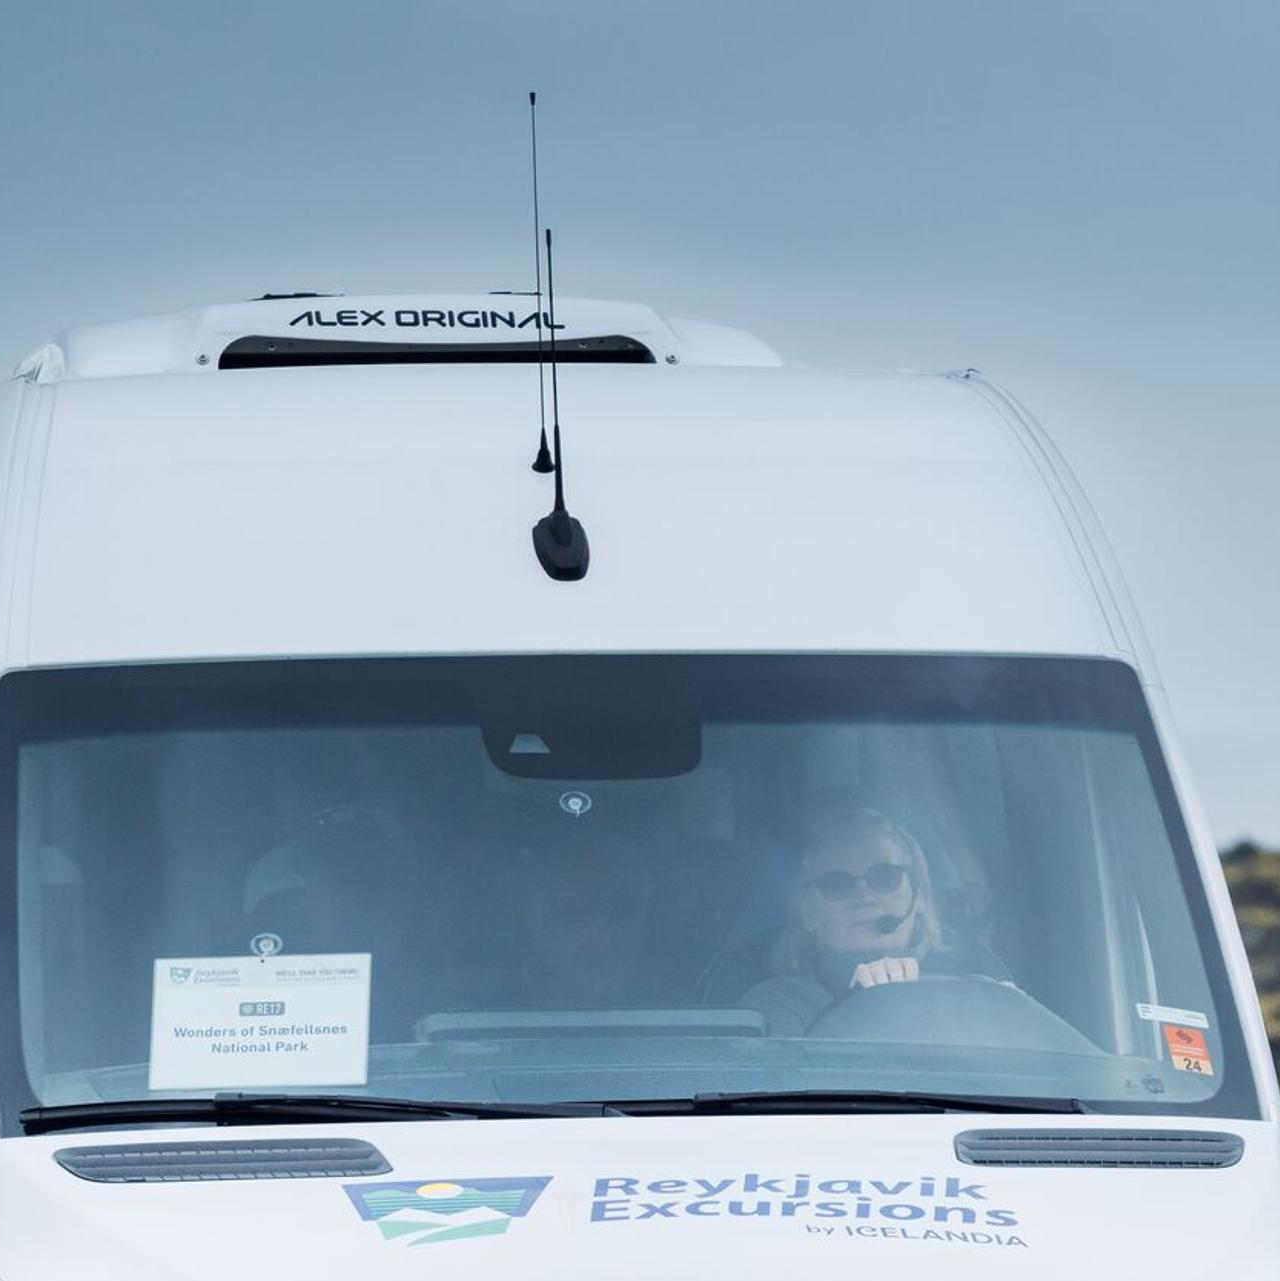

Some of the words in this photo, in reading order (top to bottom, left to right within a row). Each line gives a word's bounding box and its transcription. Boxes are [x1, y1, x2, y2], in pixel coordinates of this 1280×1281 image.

[289, 310, 385, 326] ALEX
[394, 310, 565, 329] ORIGINAL
[174, 1026, 236, 1038] Wonders
[240, 1026, 254, 1037] of
[258, 1024, 348, 1036] Snæfellsnes
[211, 1041, 271, 1054] National
[275, 1040, 309, 1052] Park
[1183, 1057, 1202, 1072] 24
[593, 1173, 990, 1200] Reykjavik
[589, 1197, 1019, 1227] Excursions
[805, 1224, 834, 1237] by
[846, 1225, 1029, 1248] ICELANDIA
